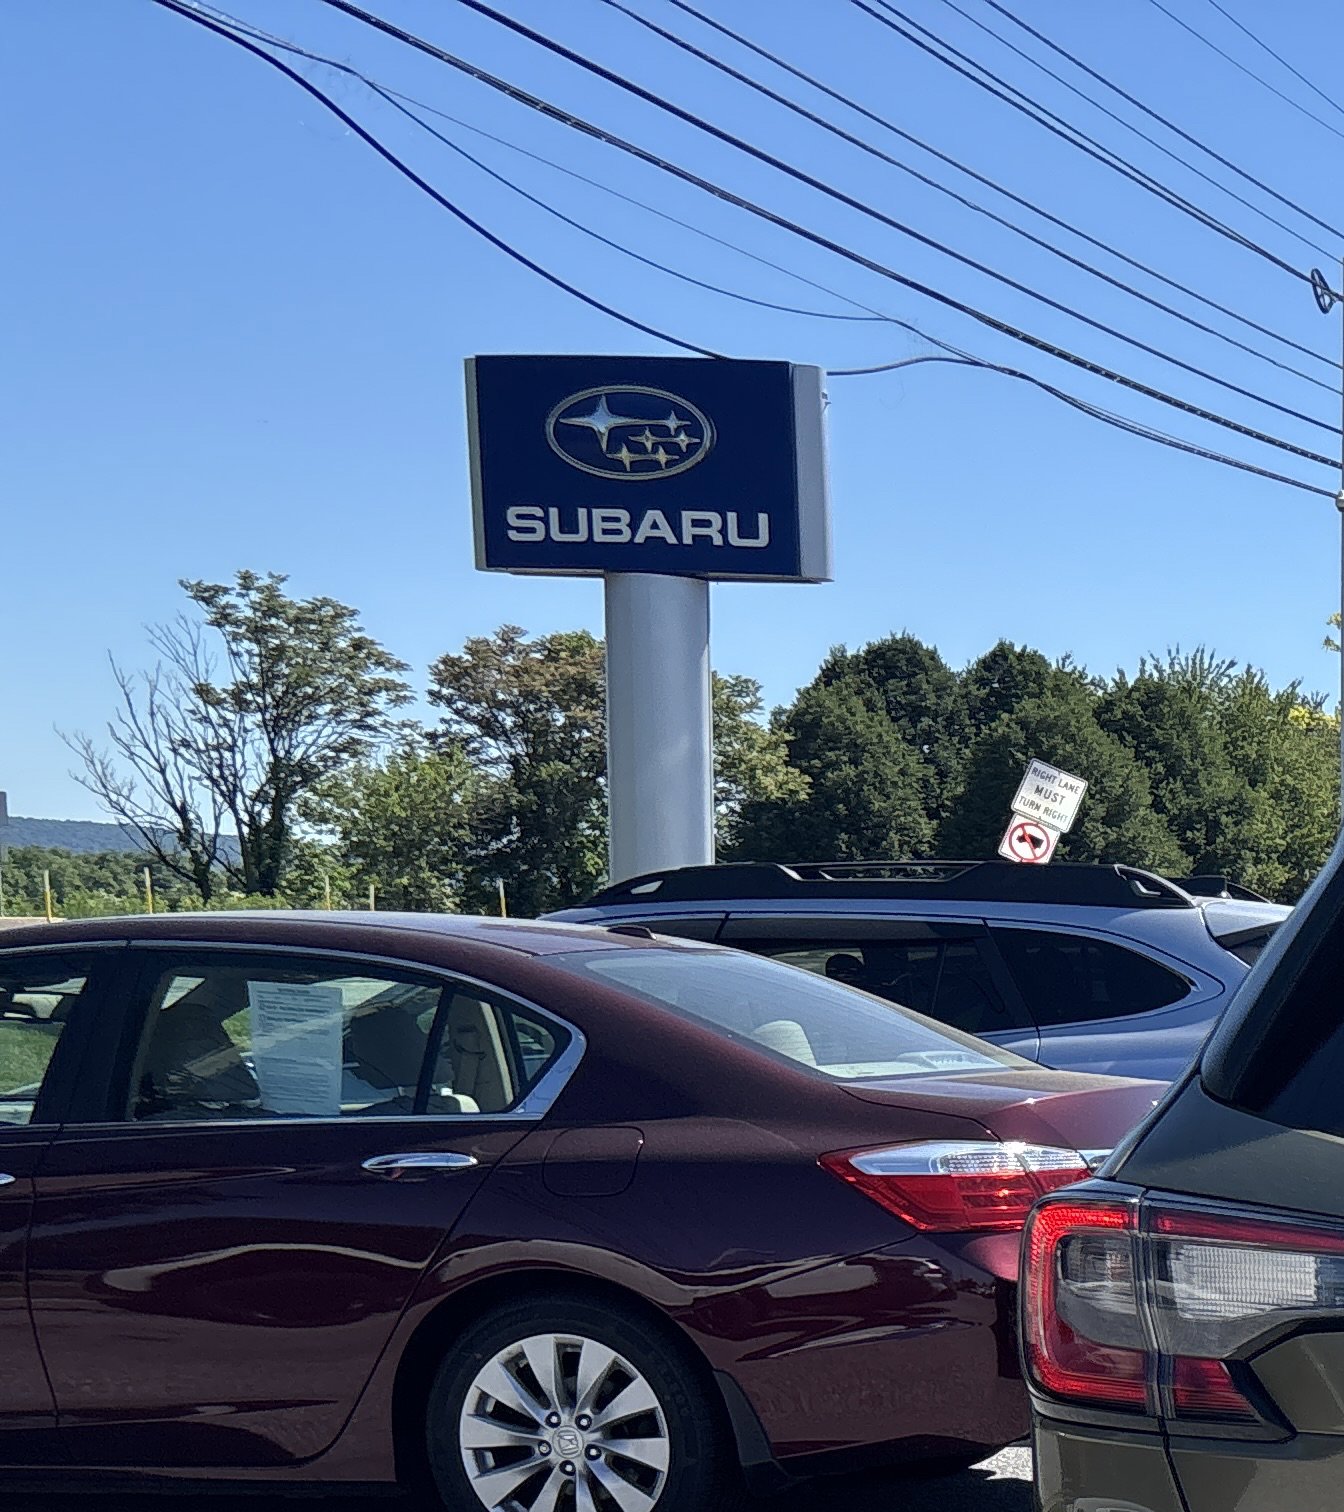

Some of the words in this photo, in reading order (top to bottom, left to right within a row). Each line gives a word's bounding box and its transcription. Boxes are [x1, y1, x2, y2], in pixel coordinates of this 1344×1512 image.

[506, 506, 769, 548] SUBARU
[1031, 767, 1057, 784] RIGHT
[1058, 779, 1080, 794] LANE
[1034, 785, 1066, 805] MUST
[1019, 796, 1041, 811] TURN
[1043, 807, 1068, 822] RIGHT
